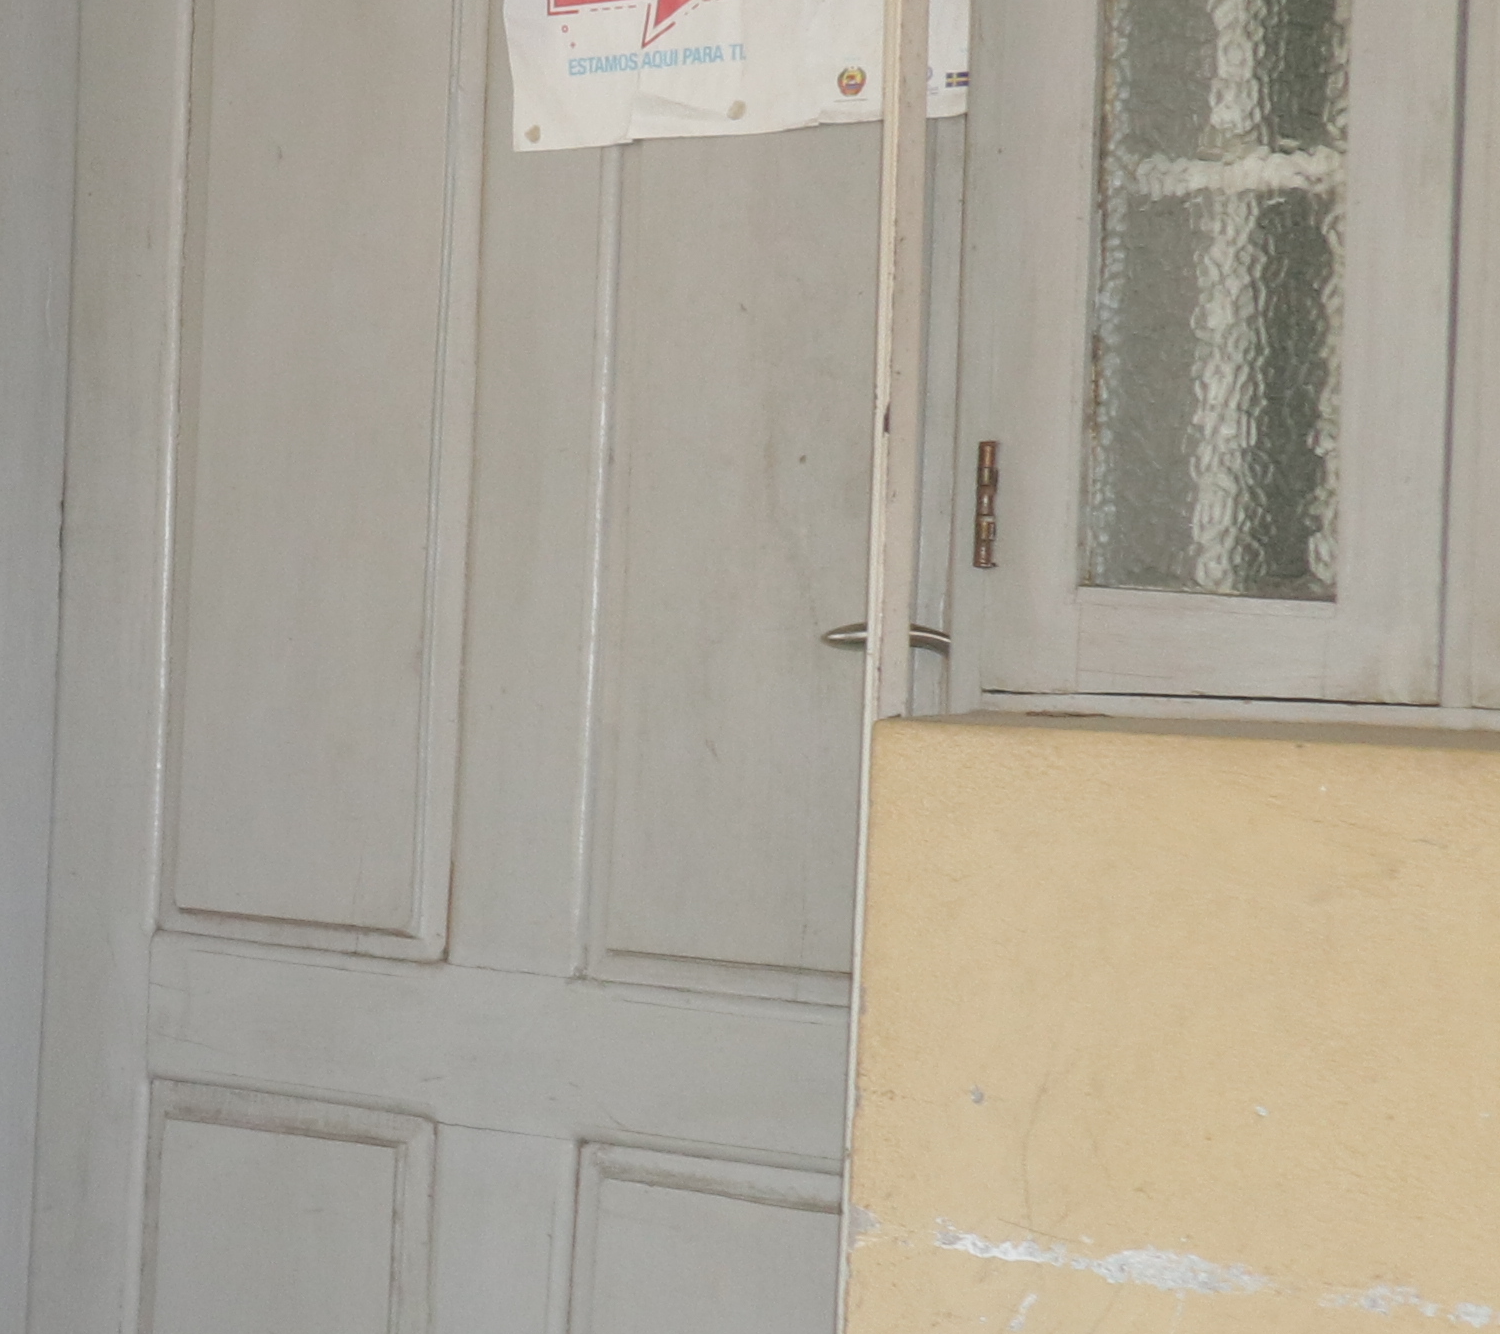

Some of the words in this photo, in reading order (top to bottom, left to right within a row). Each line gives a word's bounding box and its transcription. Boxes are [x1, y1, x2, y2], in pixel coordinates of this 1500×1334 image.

[568, 52, 639, 76] ESTAMOS
[640, 48, 679, 69] AQUI
[682, 45, 725, 66] PARA
[728, 43, 747, 61] TI.
